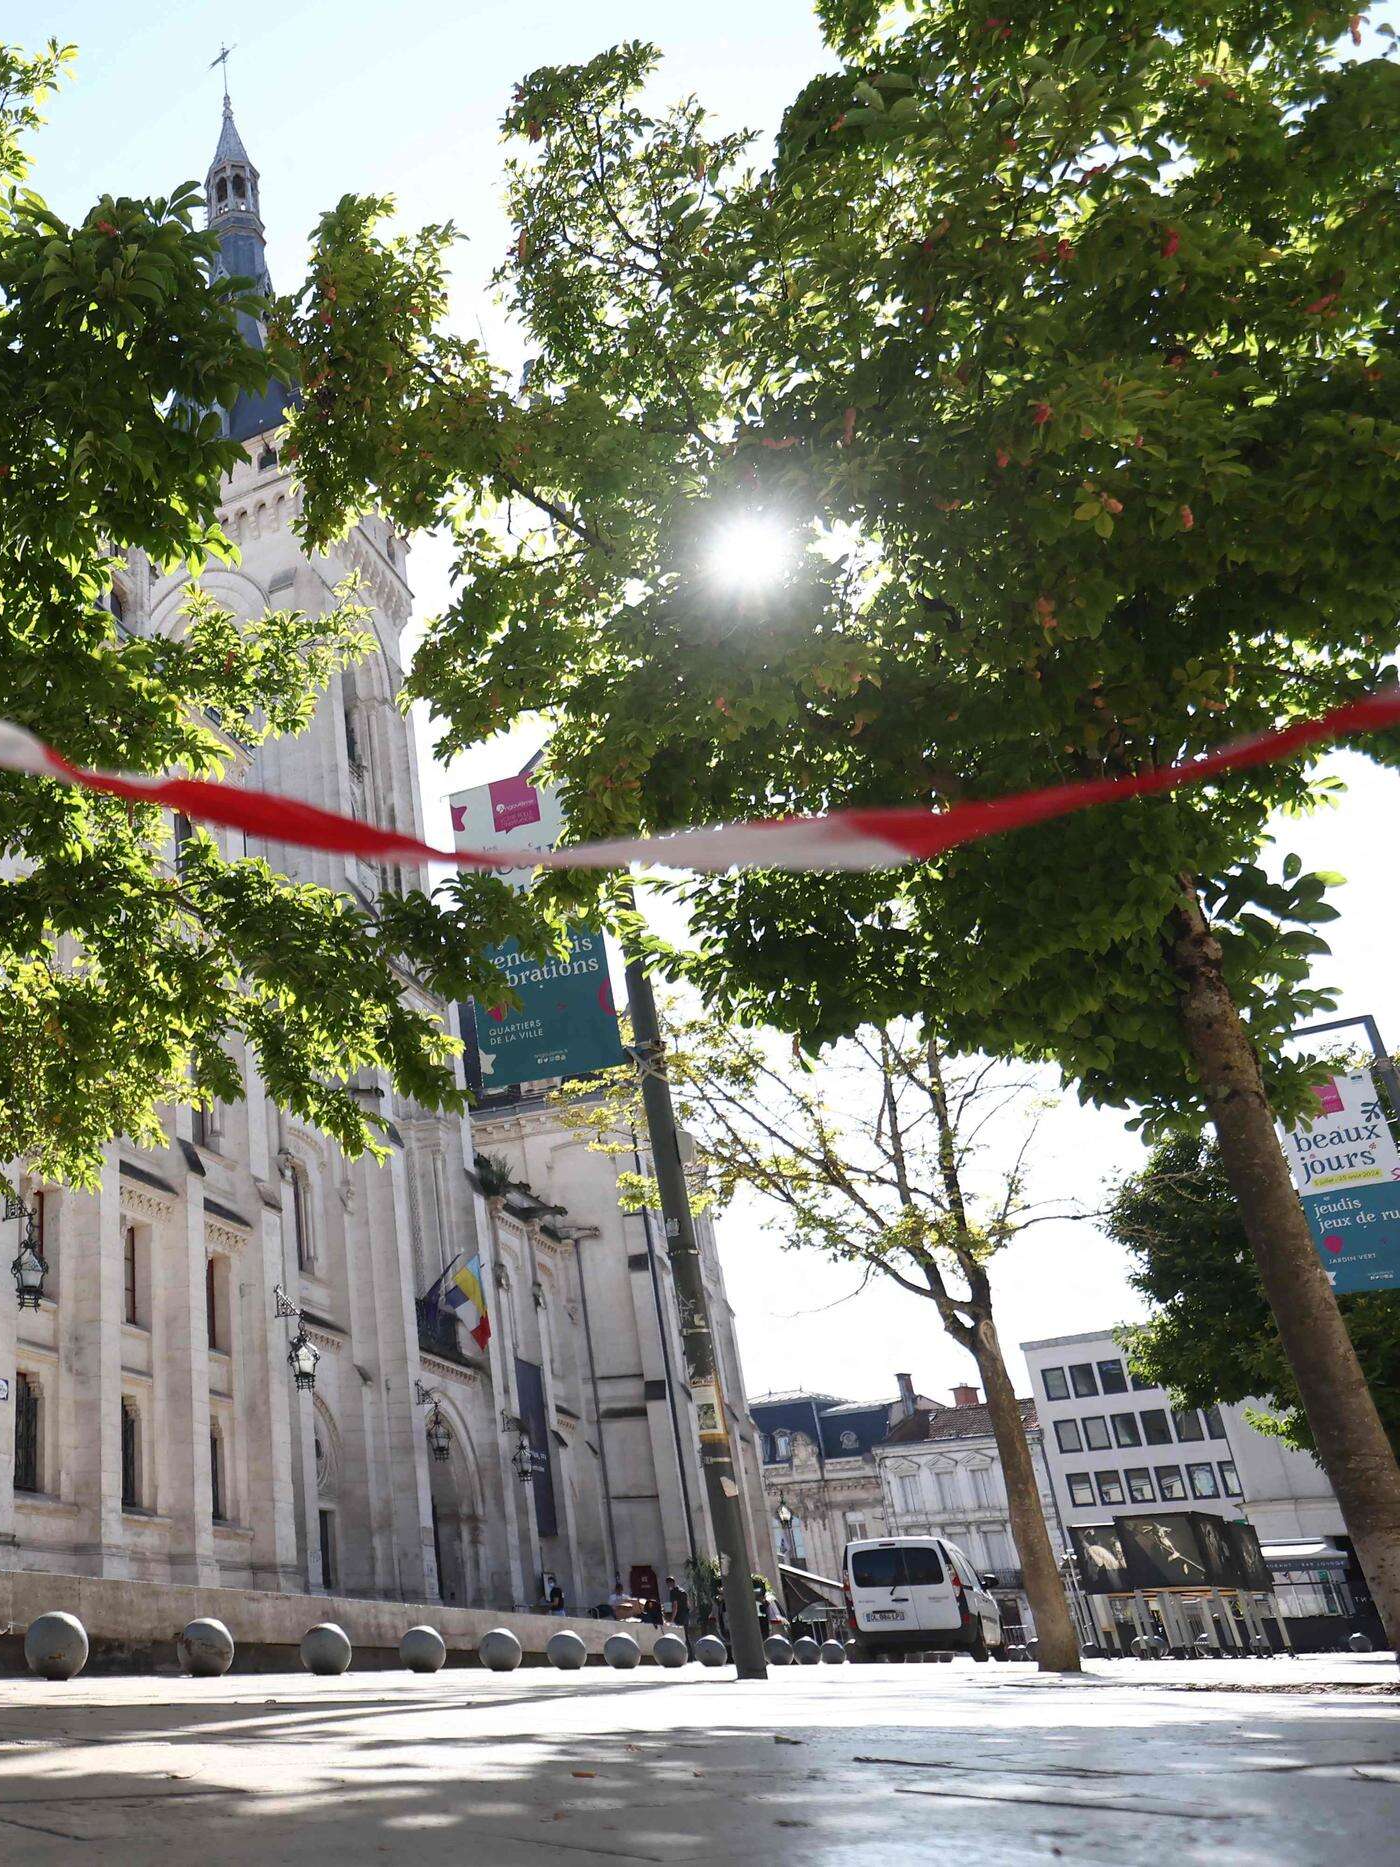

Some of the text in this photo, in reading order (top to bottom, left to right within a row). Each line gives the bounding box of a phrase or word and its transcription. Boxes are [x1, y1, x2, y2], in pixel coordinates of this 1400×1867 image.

[505, 957, 599, 988] brations
[488, 1020, 542, 1036] QUARTIERS
[490, 1028, 544, 1045] DE LA VILLE
[1292, 1124, 1382, 1153] beaux
[1300, 1150, 1376, 1184] jours
[1313, 1197, 1362, 1218] jeudis
[1318, 1217, 1352, 1234] jeux
[1355, 1211, 1376, 1224] de
[1329, 1252, 1376, 1264] JARDIN VERT
